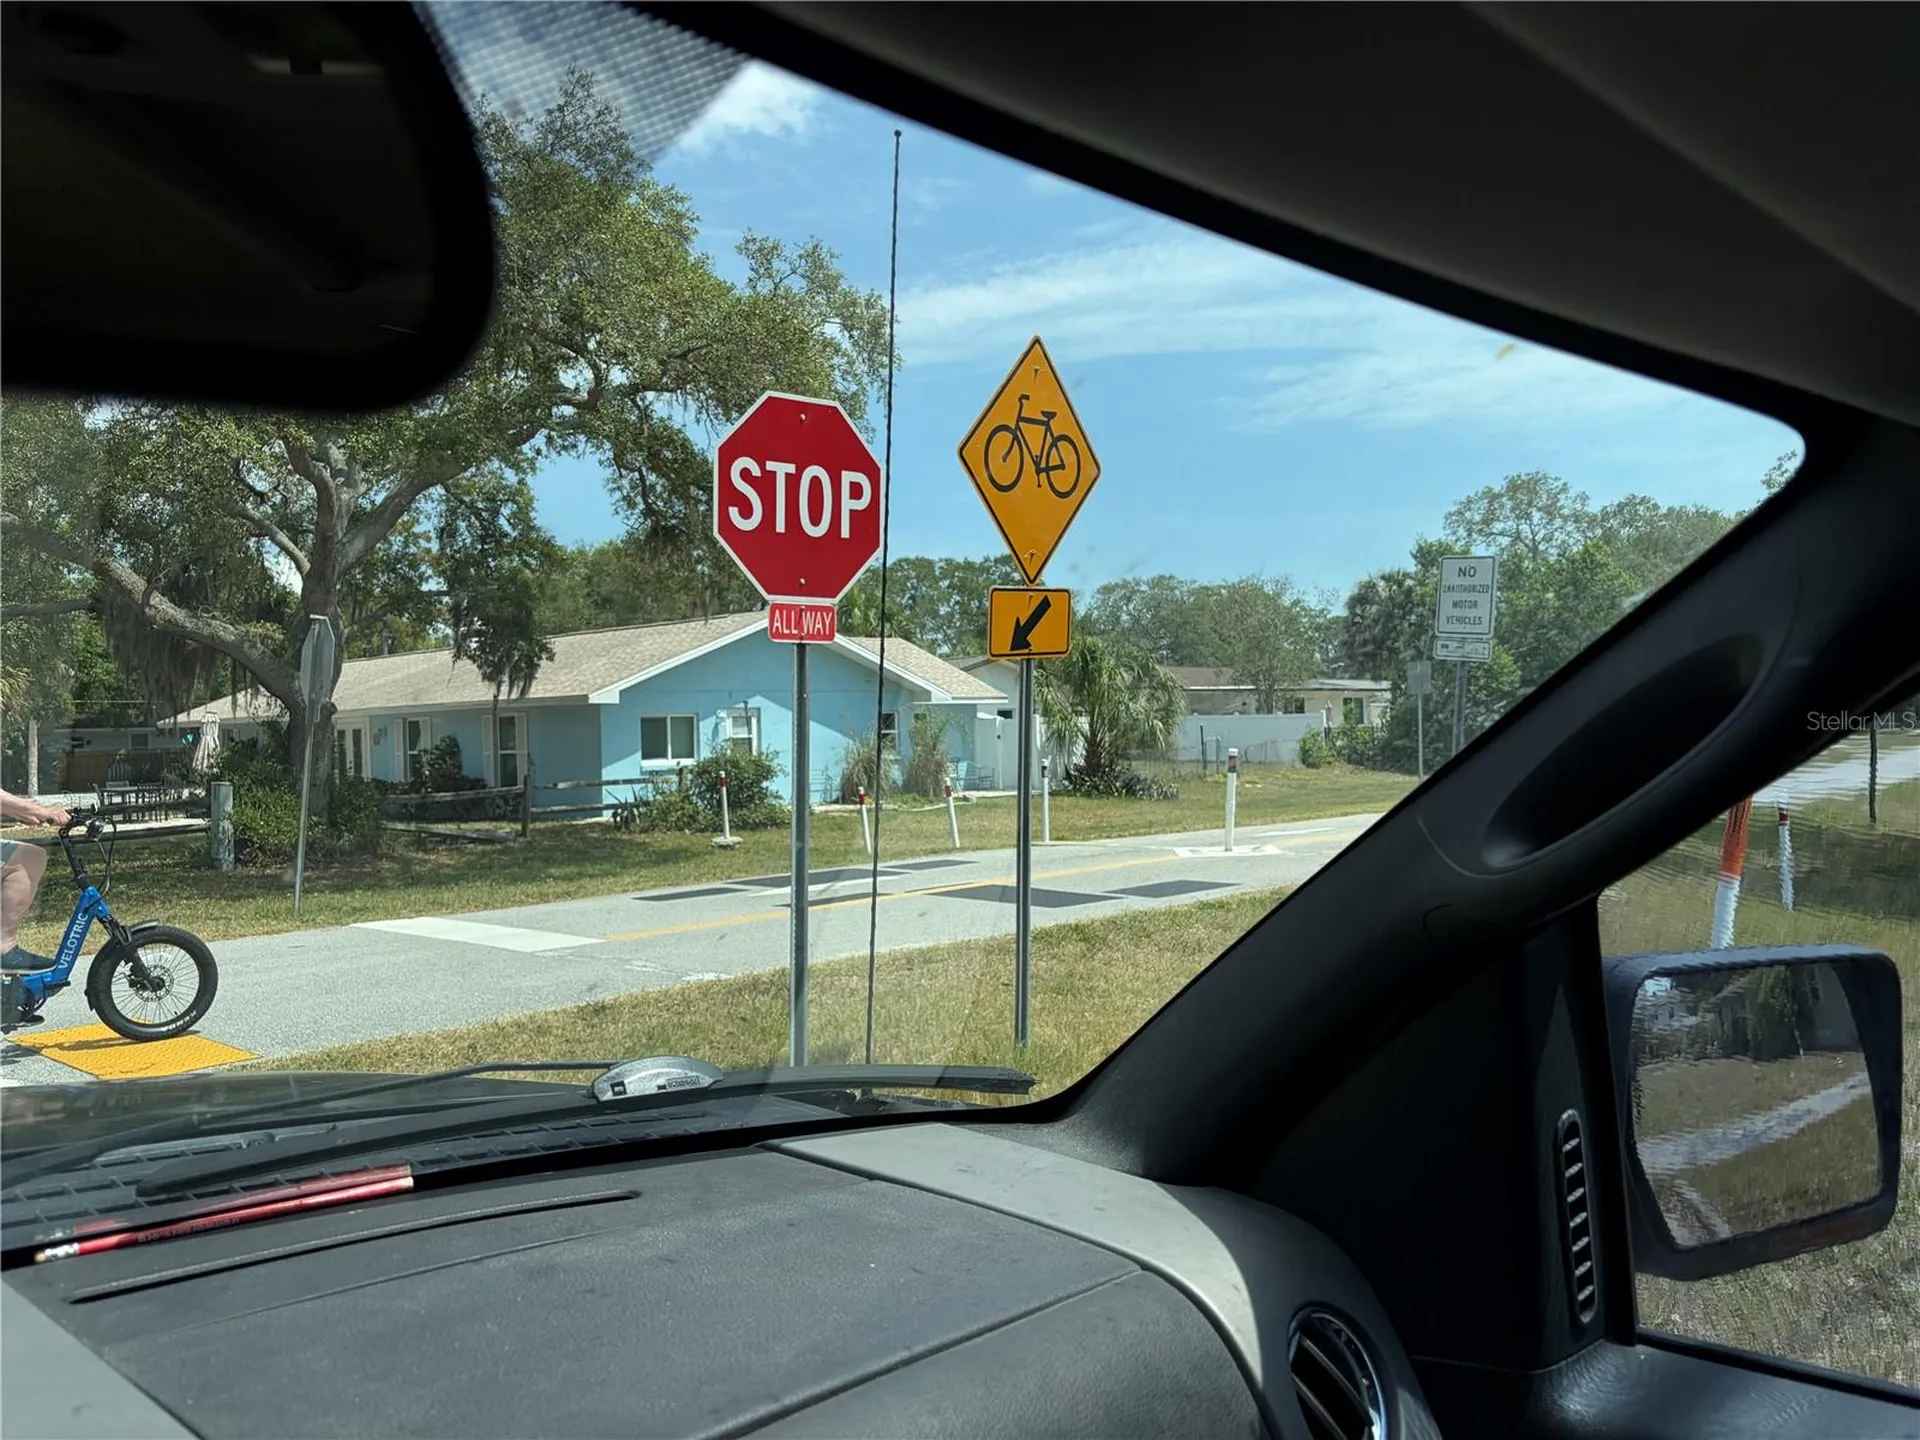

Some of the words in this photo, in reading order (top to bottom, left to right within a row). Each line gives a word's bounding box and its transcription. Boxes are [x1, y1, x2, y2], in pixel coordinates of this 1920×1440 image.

[728, 456, 872, 539] STOP
[1458, 565, 1477, 578] NO
[1452, 599, 1478, 610] MOTOR
[772, 609, 799, 635] ALL
[802, 610, 832, 636] WAY
[1446, 615, 1483, 626] VEHICLES
[57, 912, 88, 969] VELOTRIC
